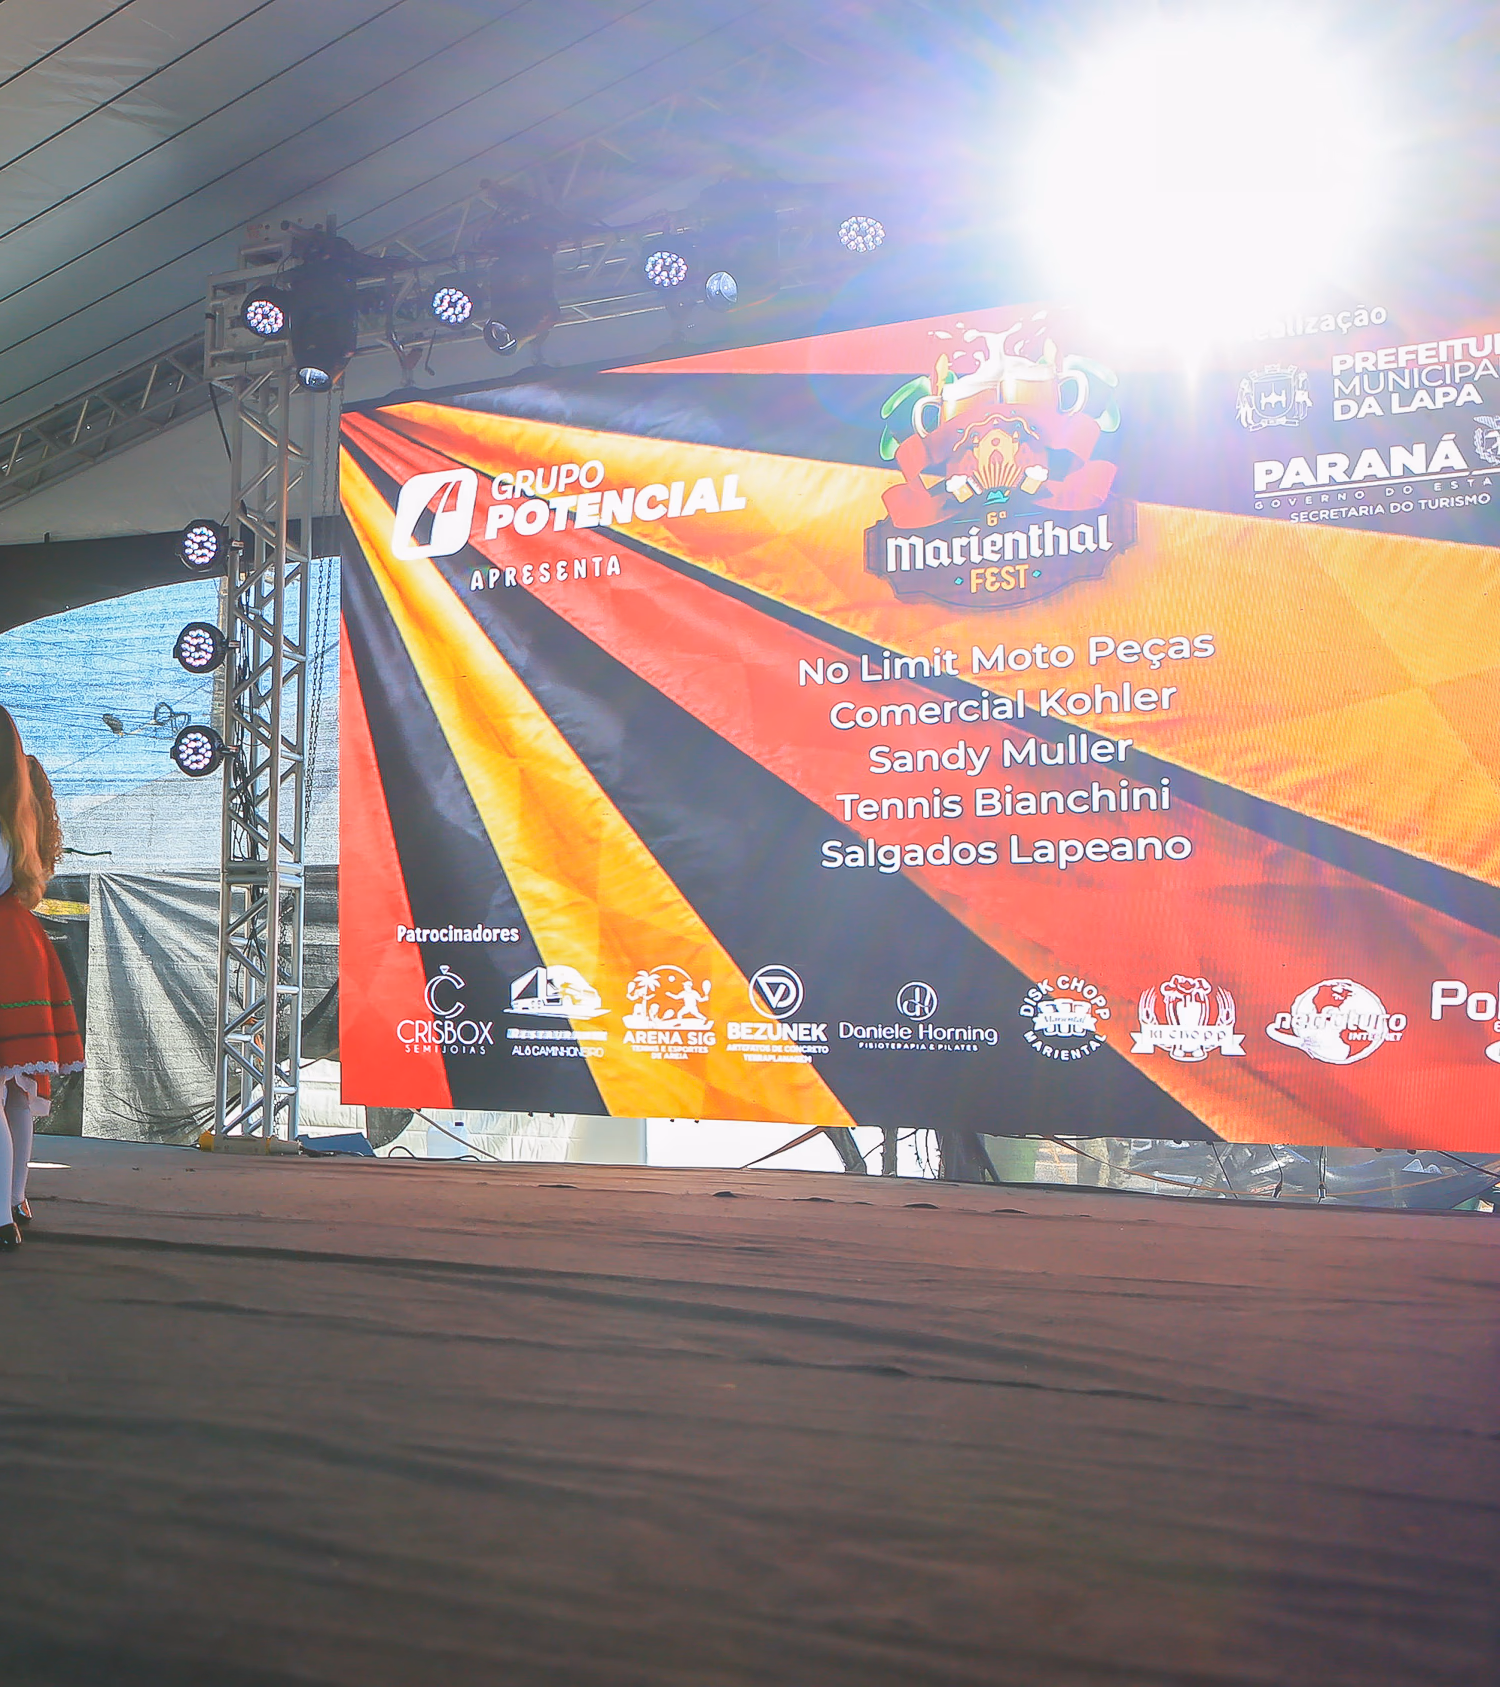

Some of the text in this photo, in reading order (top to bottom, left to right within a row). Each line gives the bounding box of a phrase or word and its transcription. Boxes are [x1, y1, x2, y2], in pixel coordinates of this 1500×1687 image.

[1250, 303, 1388, 341] ealização
[1332, 357, 1500, 399] MUNICIPA
[1332, 382, 1484, 422] DA LAPA
[490, 459, 605, 501] GRUPO
[1253, 432, 1470, 493] PARANÁ
[484, 473, 748, 541] POTENCIAL
[1254, 489, 1366, 511] GOVERNO
[1384, 486, 1414, 498] DO
[1289, 493, 1492, 524] SECRETARIA DO TURISMO
[885, 514, 1114, 573] Marienthal
[469, 554, 622, 592] APRESENTA
[969, 563, 1030, 594] FEST
[798, 632, 1216, 687] No Limit Moto Peças
[829, 680, 1178, 731] Comercial Kohler
[867, 732, 1134, 777] Sandy Muller
[835, 776, 1172, 823] Tennis Bianchini
[820, 833, 1193, 875] Salgados Lapeano
[396, 922, 520, 943] Patrocinadores
[1018, 977, 1055, 1018] DISK
[1056, 974, 1112, 1020] CHOPP
[1430, 978, 1500, 1022] Po
[396, 1018, 495, 1045] CRISBOX
[404, 1044, 486, 1055] SEMIJOIAS
[622, 1030, 717, 1046] ARENA SIG
[726, 1021, 829, 1042] BEZUNEK
[838, 1021, 999, 1047] Daniele Horning
[857, 1041, 927, 1051] FISIOTERAPIA
[937, 1043, 980, 1053] PILATES
[1023, 1030, 1108, 1062] MARIENTAL
